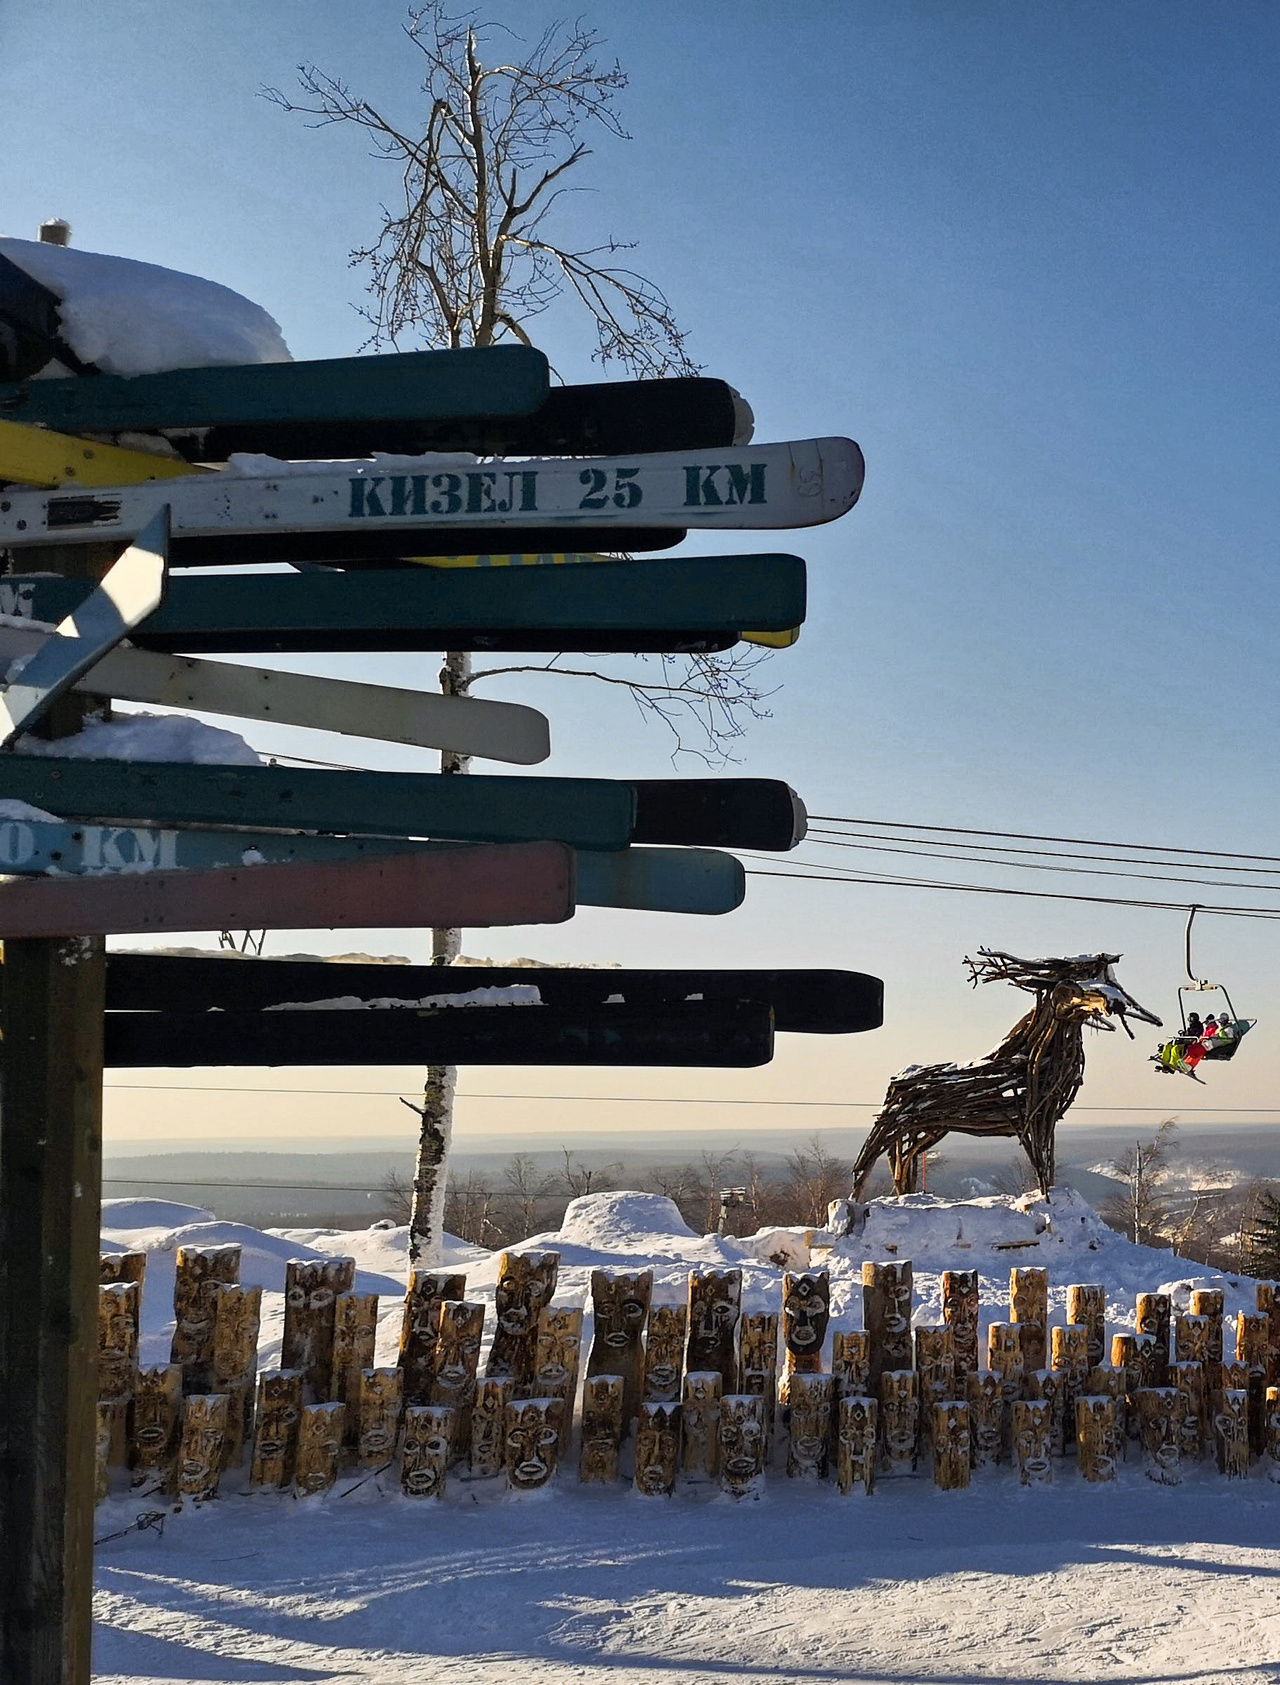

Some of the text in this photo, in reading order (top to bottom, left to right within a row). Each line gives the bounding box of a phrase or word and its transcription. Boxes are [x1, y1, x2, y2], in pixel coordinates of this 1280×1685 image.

[349, 471, 538, 517] КИЗЕЛ
[579, 467, 644, 509] 25
[683, 463, 767, 505] КМ
[80, 826, 180, 869] КМ
